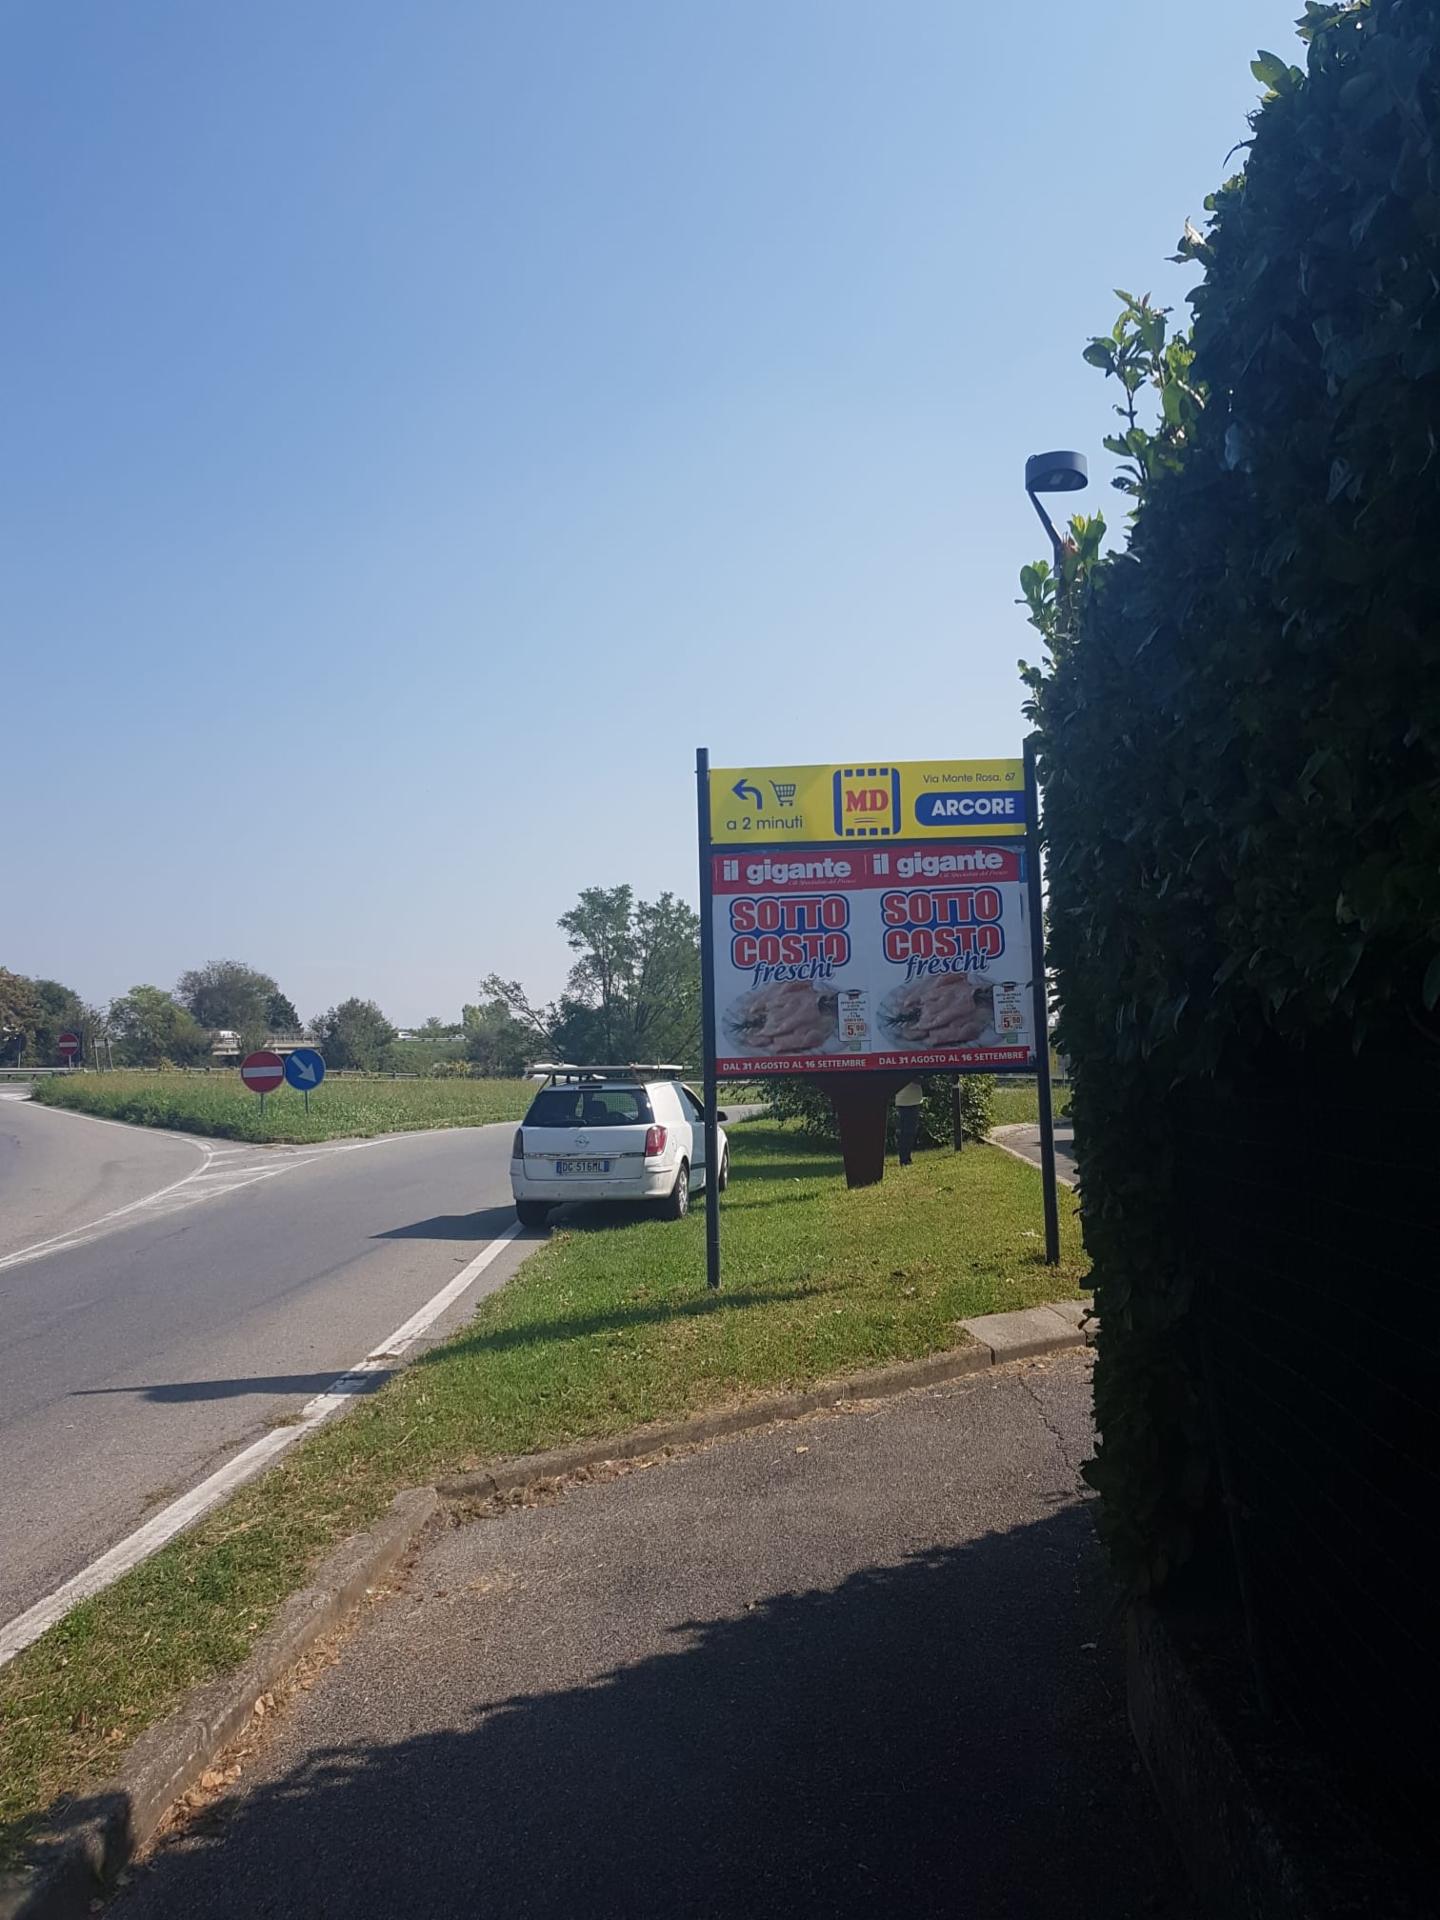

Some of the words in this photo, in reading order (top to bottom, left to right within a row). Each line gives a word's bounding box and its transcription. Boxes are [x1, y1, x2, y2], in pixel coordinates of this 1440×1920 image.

[923, 774, 939, 784] Via
[942, 774, 973, 783] Monte
[1005, 772, 1015, 782] 67
[846, 789, 888, 812] MD
[931, 797, 1015, 817] ARCORE
[726, 820, 737, 830] a
[742, 816, 751, 830] 2
[756, 815, 803, 830] minuti
[723, 860, 738, 881] il
[746, 858, 851, 885] gigante
[873, 853, 889, 875] il
[896, 850, 1003, 877] gigante
[731, 896, 849, 932] SOTTO
[882, 889, 1001, 926] SOTTO
[733, 932, 849, 968] COSTO
[885, 925, 1003, 962] COSTO
[753, 956, 835, 986] freschi
[906, 948, 989, 980] freschi
[723, 1062, 740, 1071] DAL
[754, 1061, 790, 1070] AGOSTO
[792, 1060, 803, 1069] AL
[806, 1060, 815, 1068] 16
[817, 1058, 867, 1068] SETTEMBRE
[878, 1056, 897, 1065] DAL
[899, 1056, 909, 1064] 31
[911, 1054, 946, 1063] AGOSTO
[948, 1053, 960, 1062] AL
[962, 1053, 972, 1061] 16
[974, 1051, 1024, 1060] SETTEMBRE
